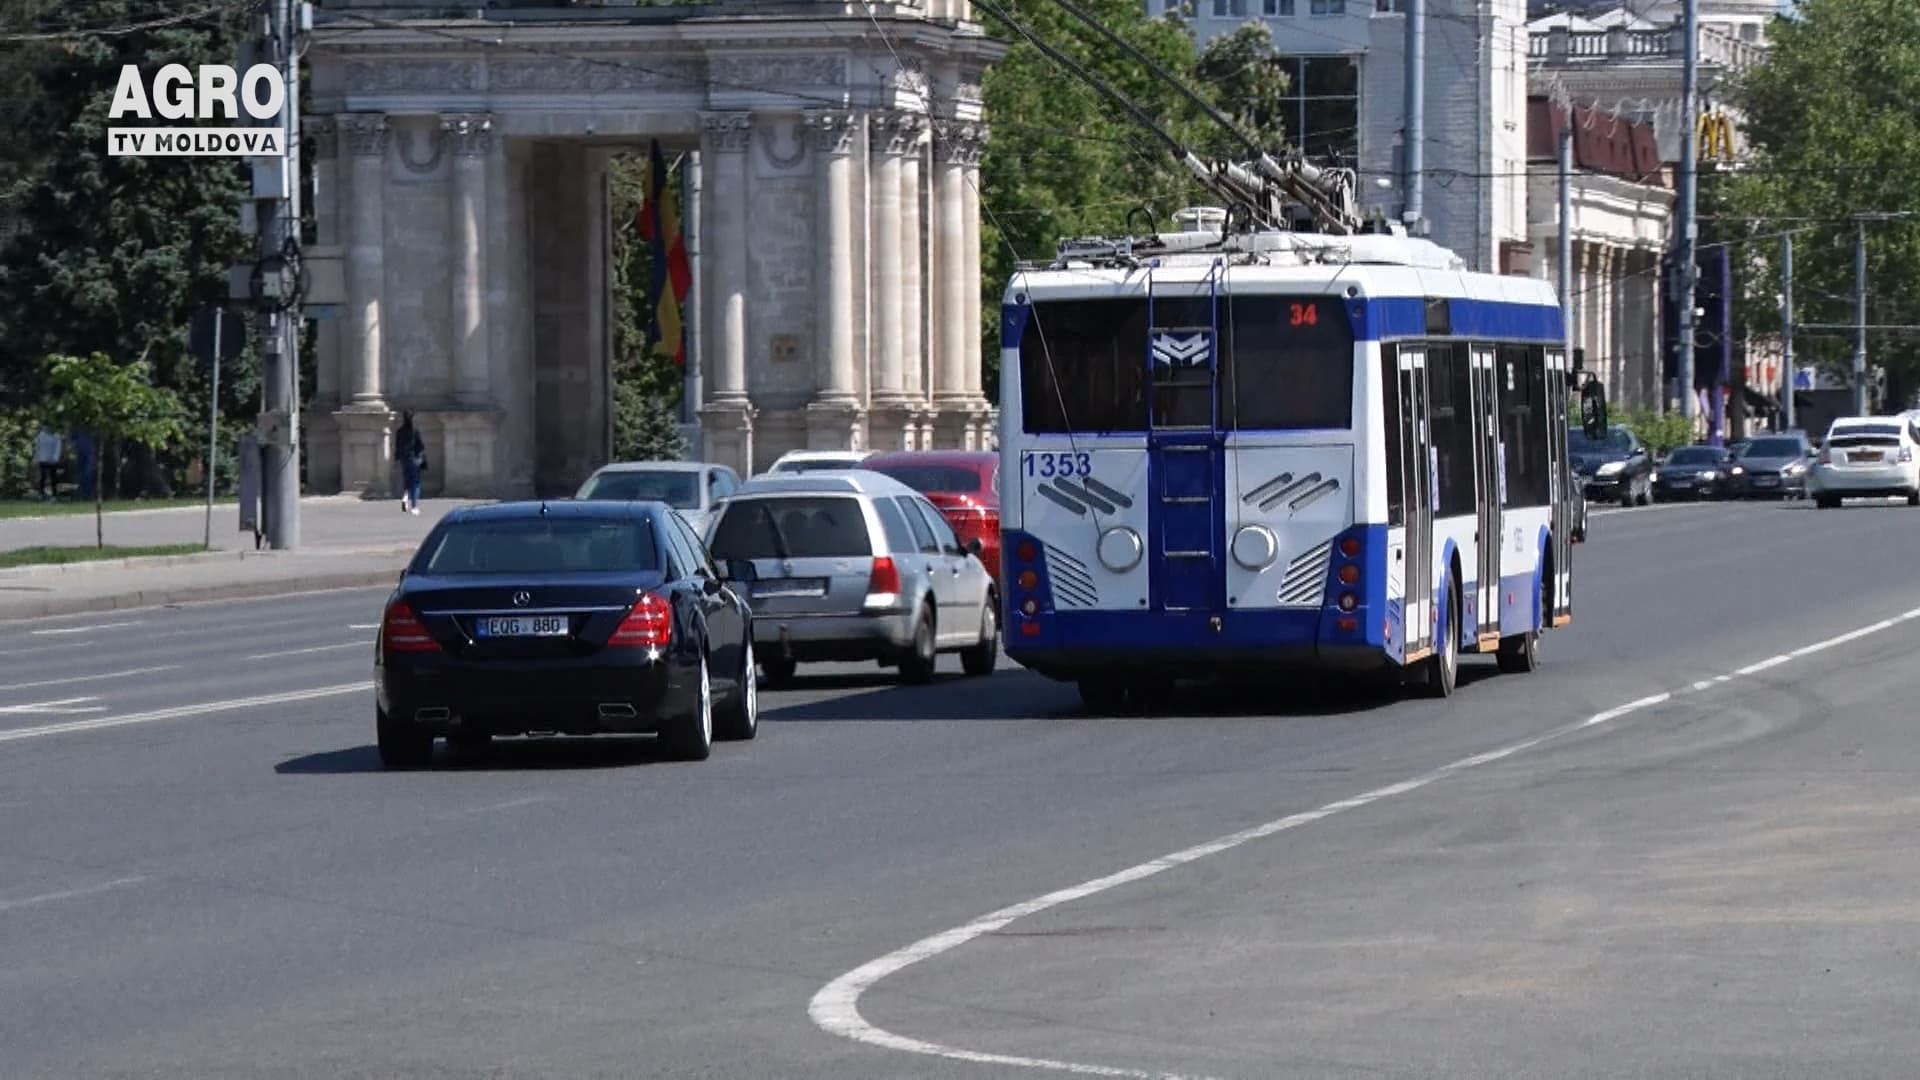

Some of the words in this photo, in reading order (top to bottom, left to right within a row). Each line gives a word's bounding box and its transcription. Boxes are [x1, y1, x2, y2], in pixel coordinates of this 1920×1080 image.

[1290, 303, 1317, 326] 34
[1023, 453, 1091, 477] 1353
[532, 618, 560, 633] 880
